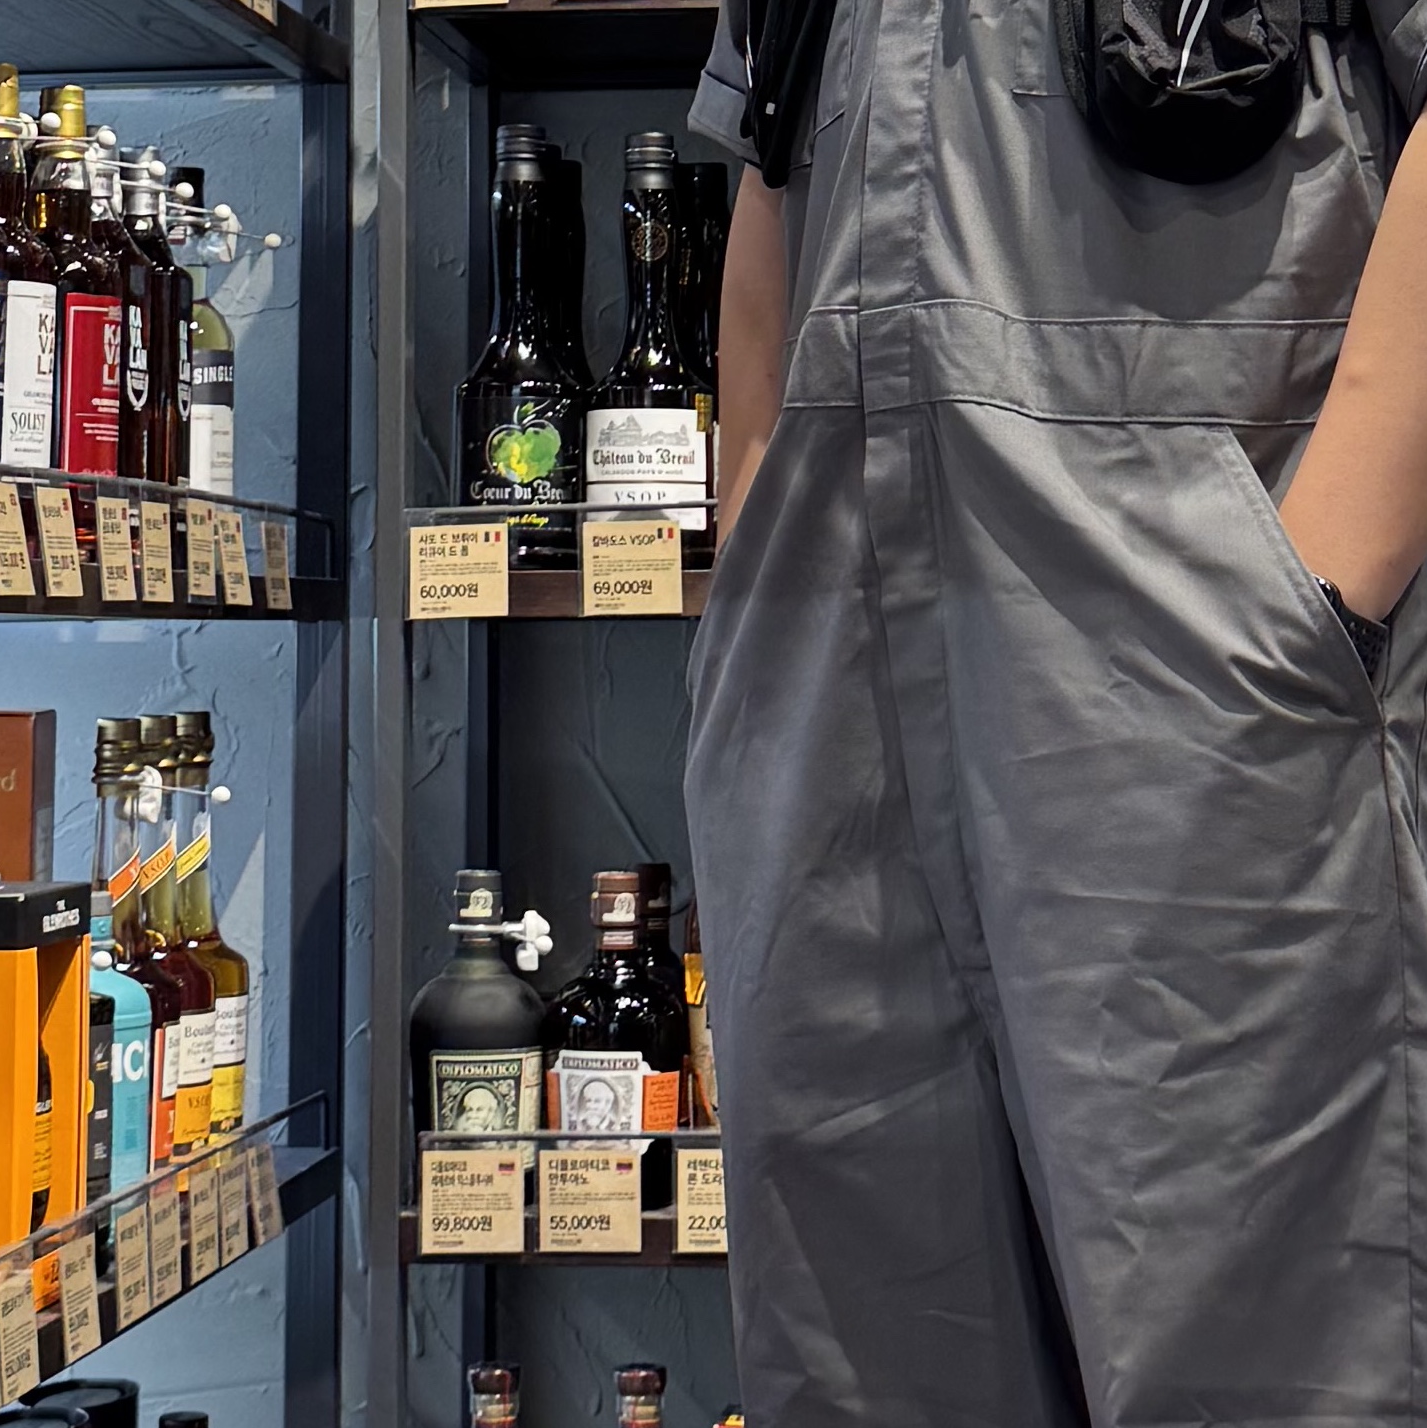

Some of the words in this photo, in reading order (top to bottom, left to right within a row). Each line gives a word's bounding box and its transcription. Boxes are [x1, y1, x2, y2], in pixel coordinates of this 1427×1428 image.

[193, 365, 234, 384] SINGLE
[629, 534, 657, 547] VSOP
[419, 582, 480, 600] 60,000원
[592, 579, 654, 596] 69,000원
[441, 1061, 519, 1076] DIPLOMATICO
[431, 1215, 493, 1232] 99,800원
[549, 1215, 611, 1232] 55,000원
